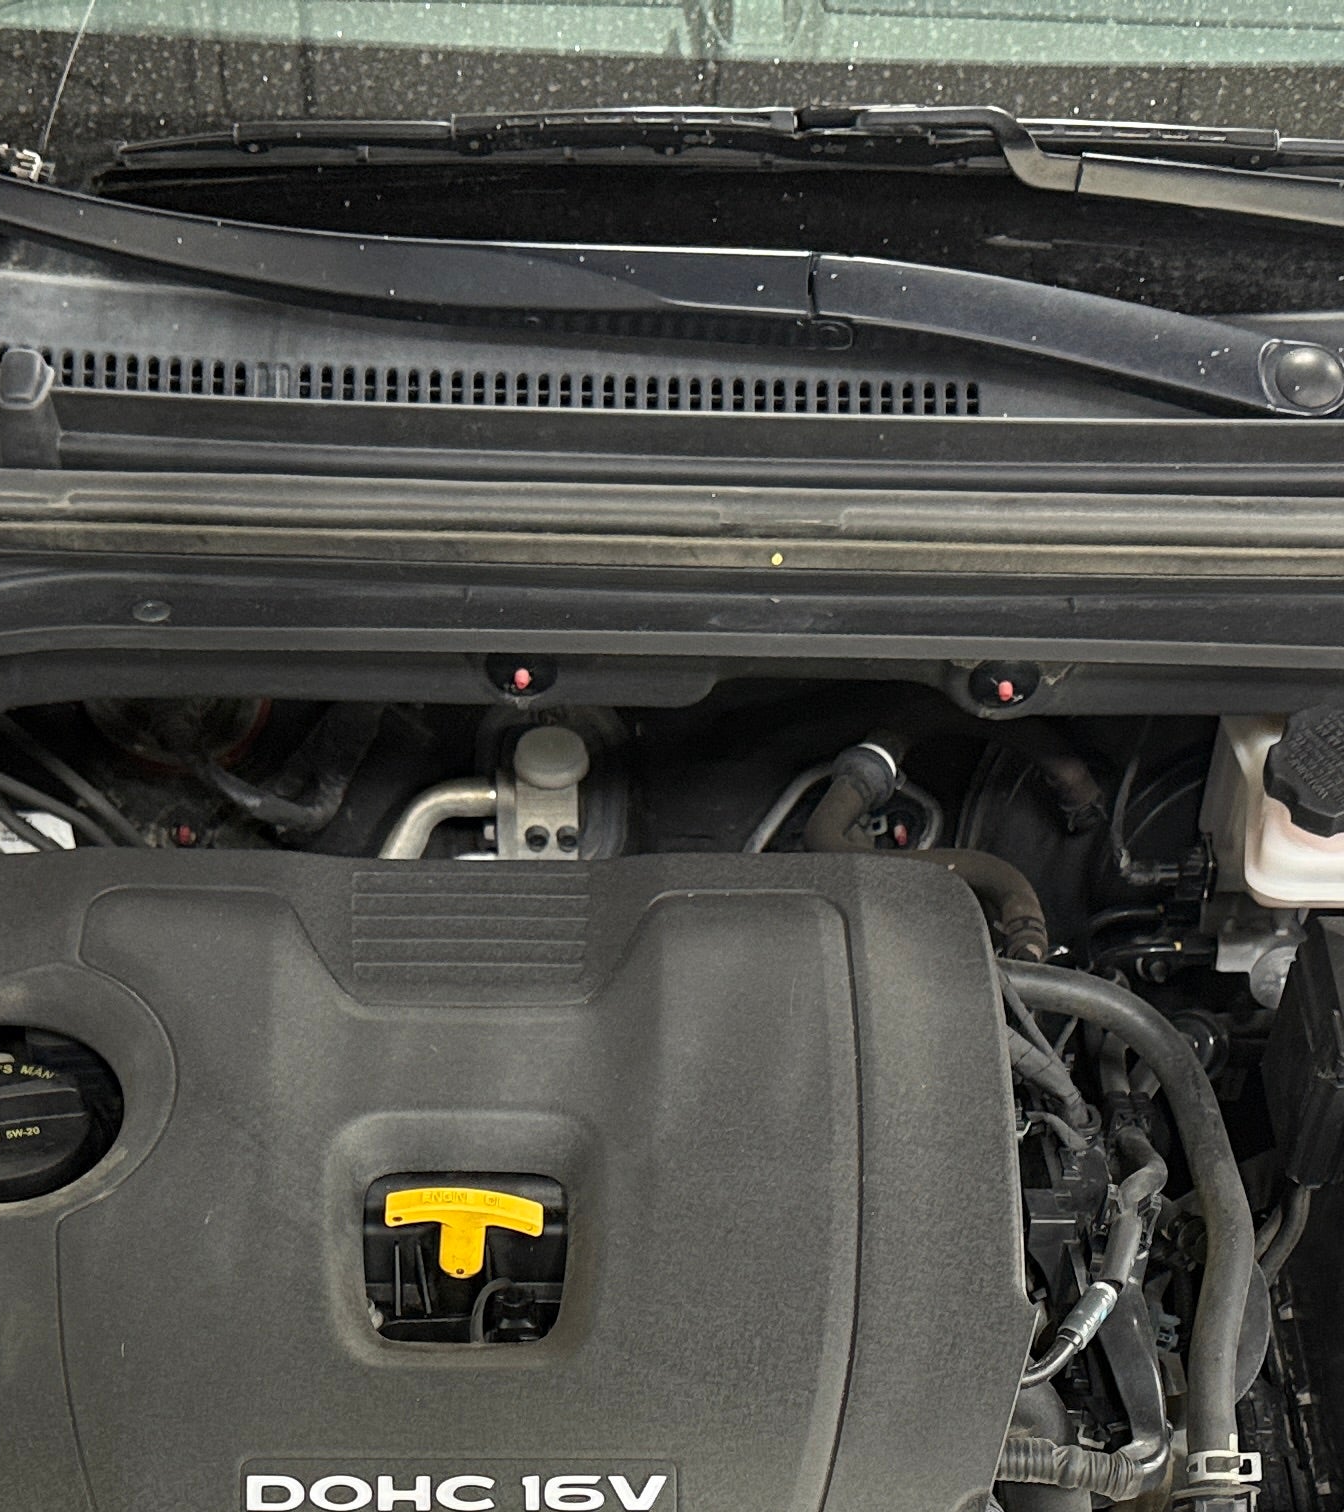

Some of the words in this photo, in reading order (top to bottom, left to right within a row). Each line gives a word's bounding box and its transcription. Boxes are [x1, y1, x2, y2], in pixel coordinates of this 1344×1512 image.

[5, 1126, 41, 1140] 5W-20
[245, 1474, 497, 1512] DOHC
[521, 1474, 668, 1512] 16V
